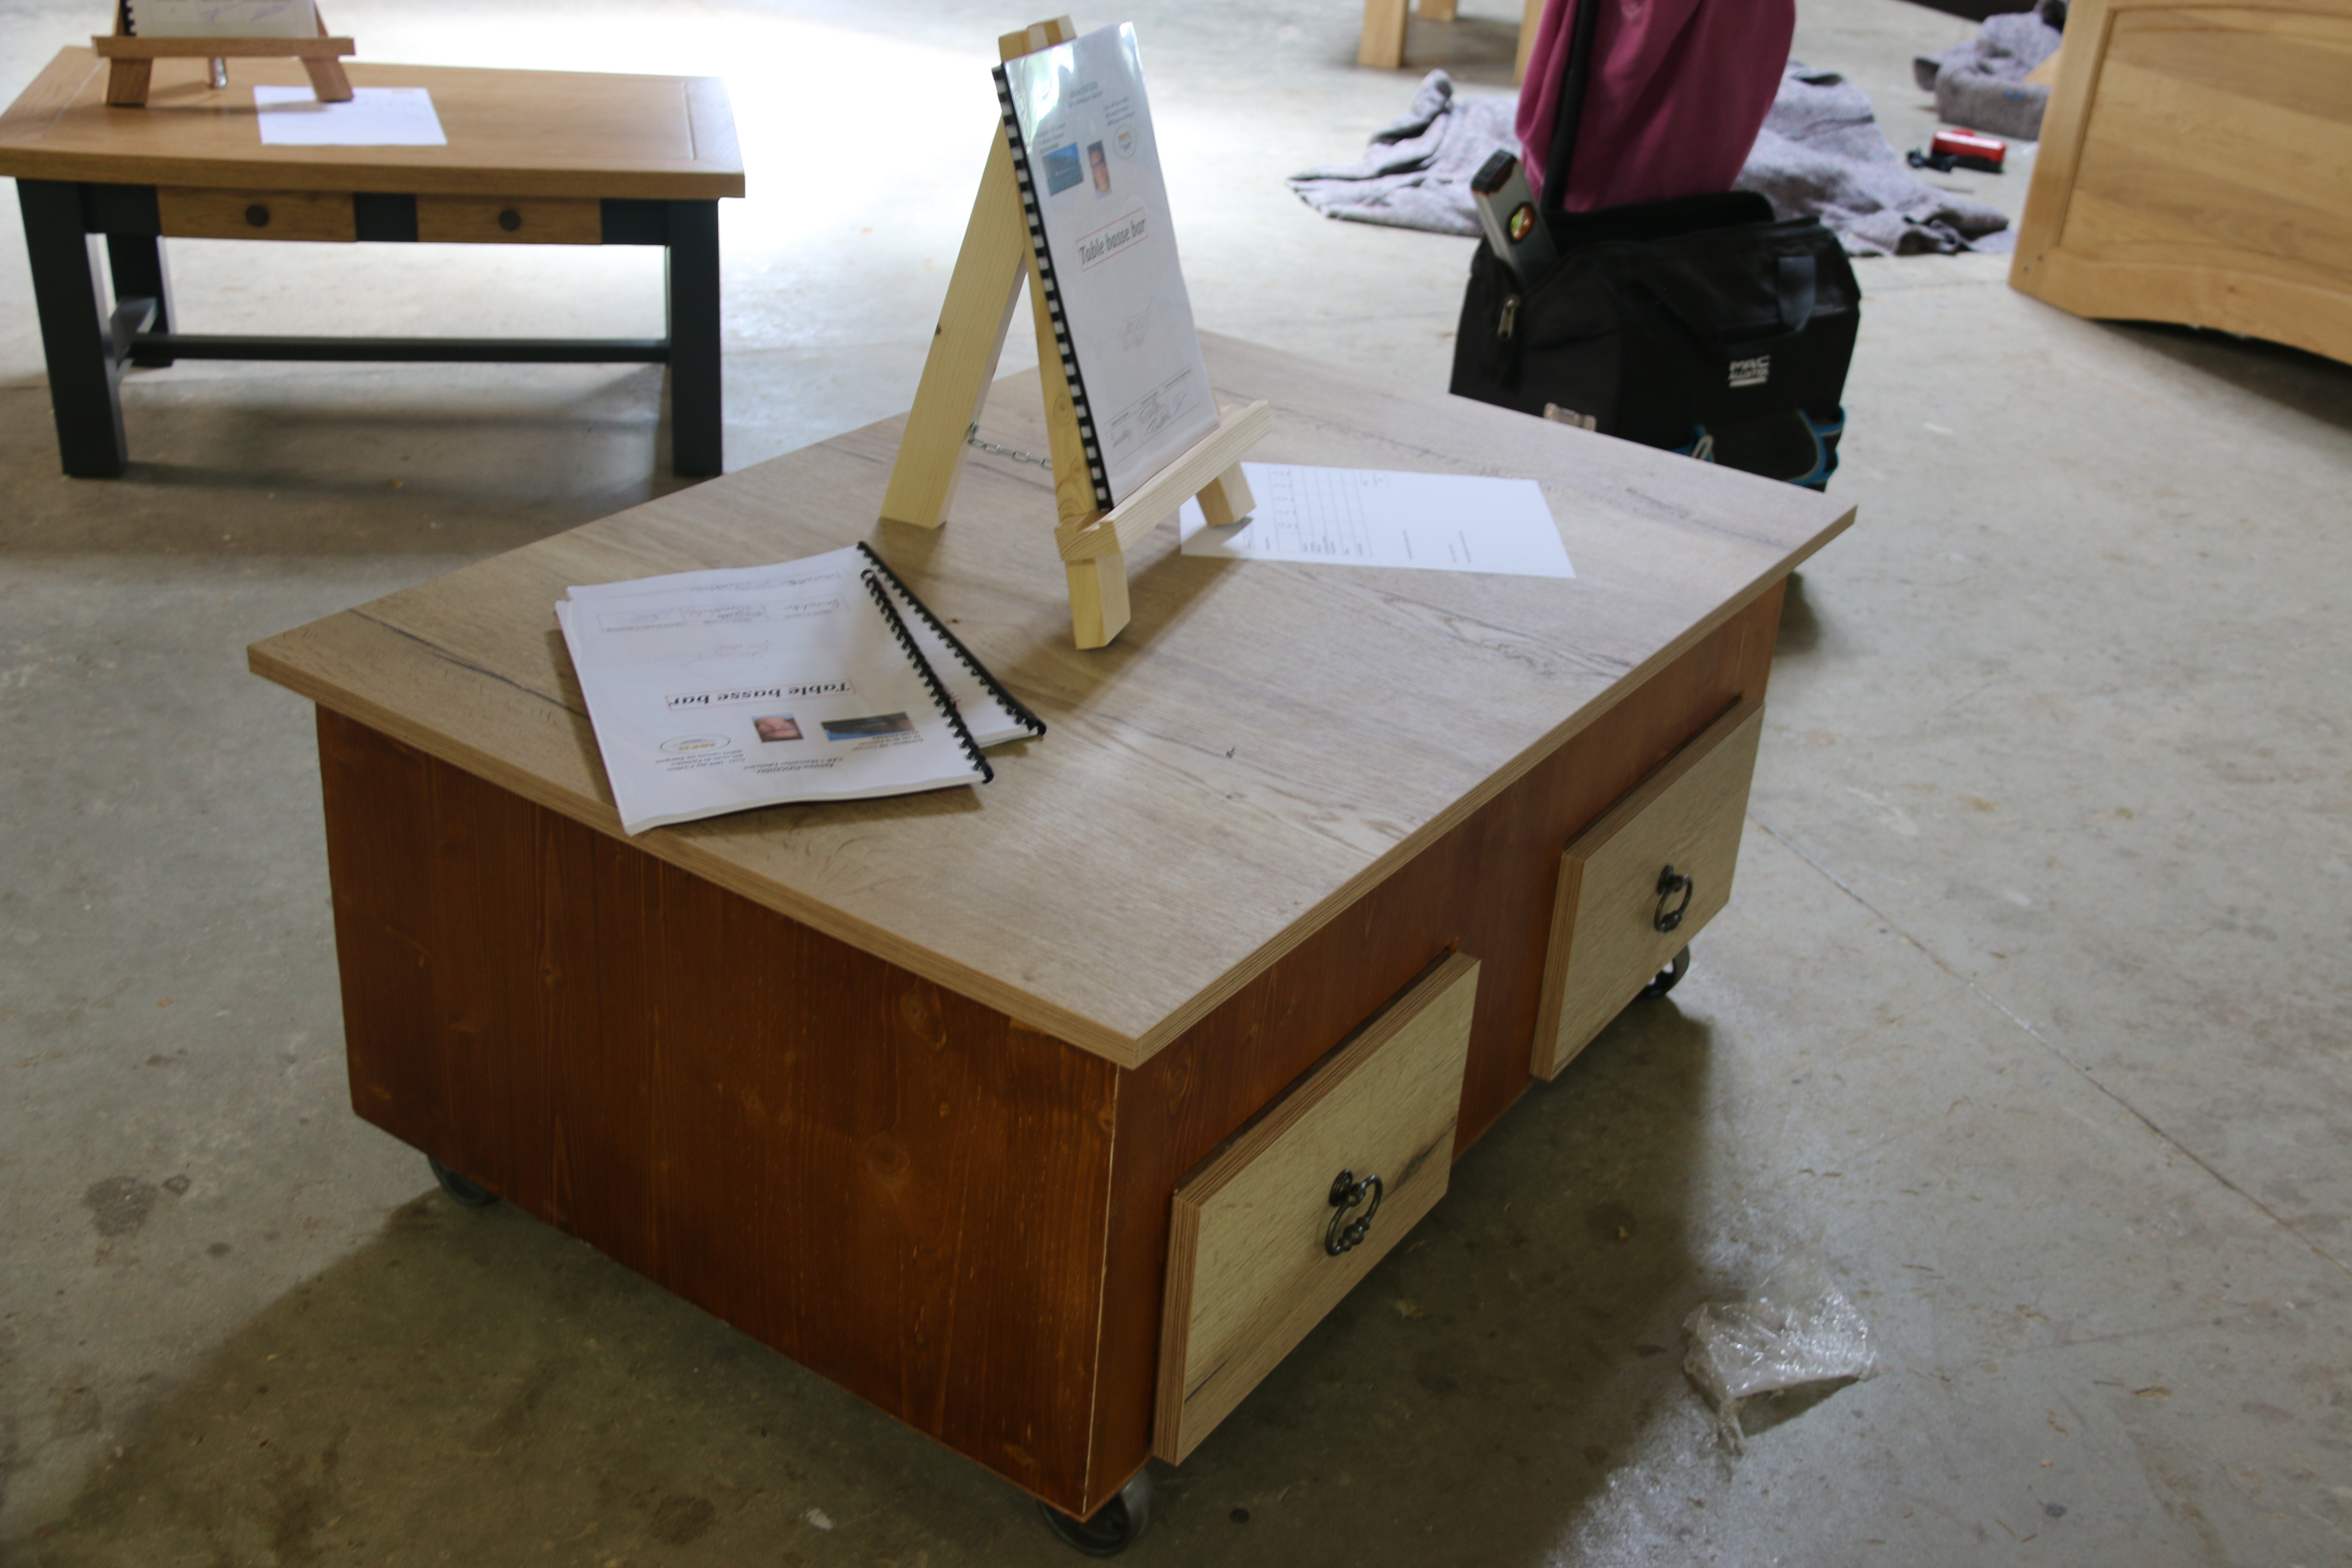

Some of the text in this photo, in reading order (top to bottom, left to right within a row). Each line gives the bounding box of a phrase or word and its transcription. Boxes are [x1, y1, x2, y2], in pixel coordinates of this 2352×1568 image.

[1079, 219, 1145, 265] Table basse bar
[669, 682, 851, 706] Table basse bar
